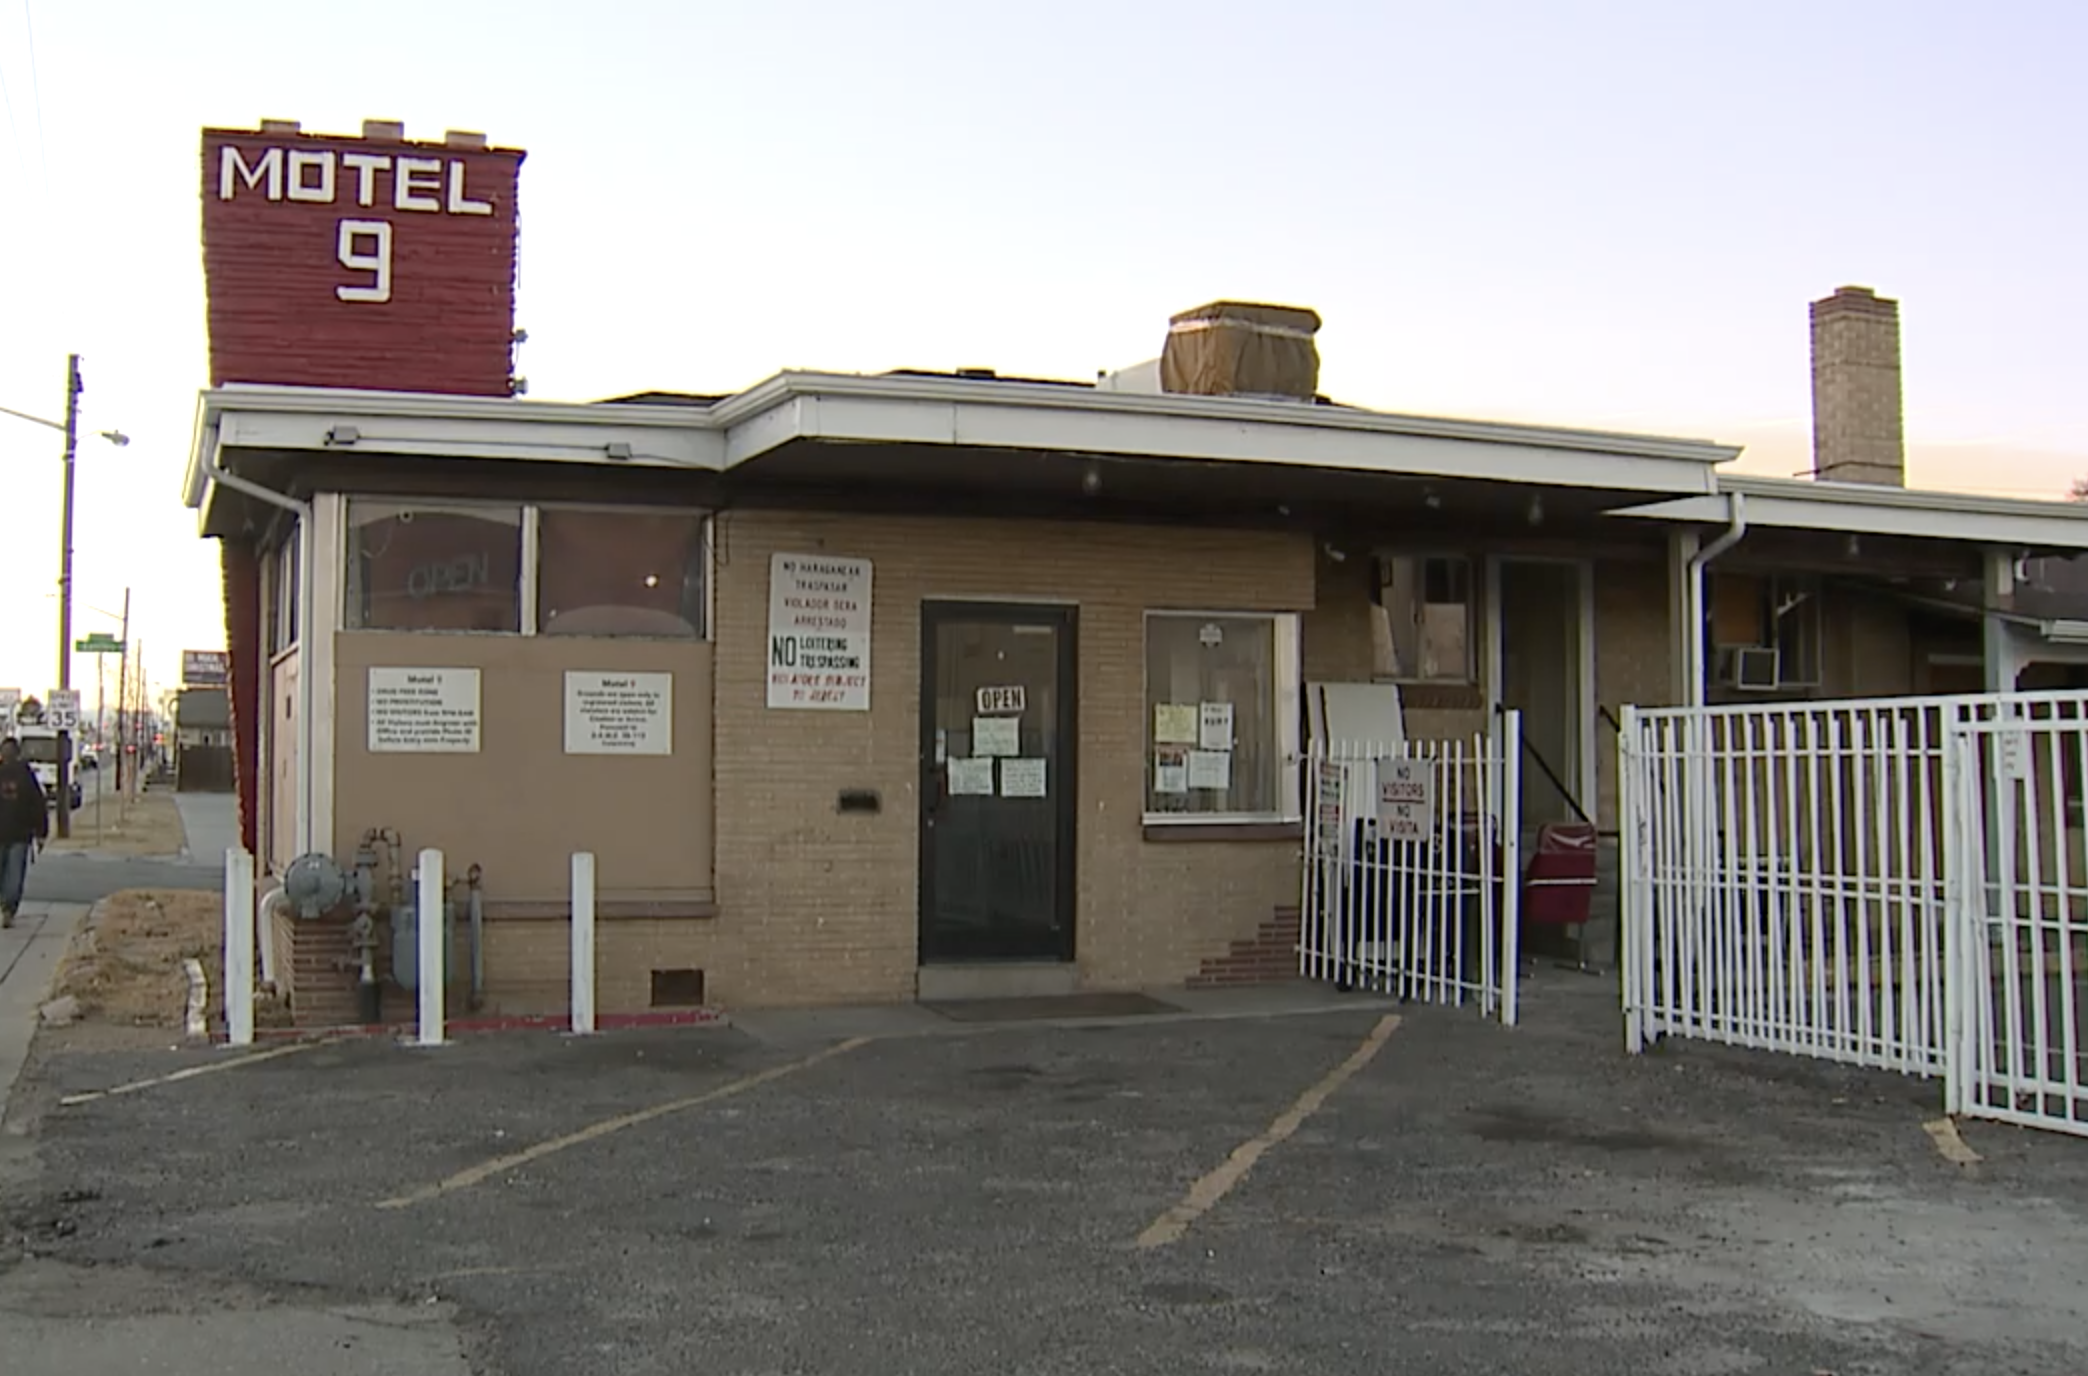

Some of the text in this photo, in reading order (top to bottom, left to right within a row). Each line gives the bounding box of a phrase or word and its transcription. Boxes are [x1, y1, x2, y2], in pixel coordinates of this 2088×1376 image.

[219, 147, 493, 215] MOTEL
[336, 219, 392, 302] 9
[783, 562, 796, 572] NO
[784, 598, 857, 611] VIOLADOR SERA
[794, 616, 847, 629] ARRESTADO
[772, 636, 847, 666] NO LOITERING
[800, 654, 860, 669] TRESPASSING
[825, 675, 866, 687] SUBECT
[981, 687, 1021, 709] OPEN
[52, 711, 76, 727] 35
[1397, 766, 1410, 780] NO
[1382, 782, 1424, 798] VISITORS
[1397, 805, 1410, 818] NO
